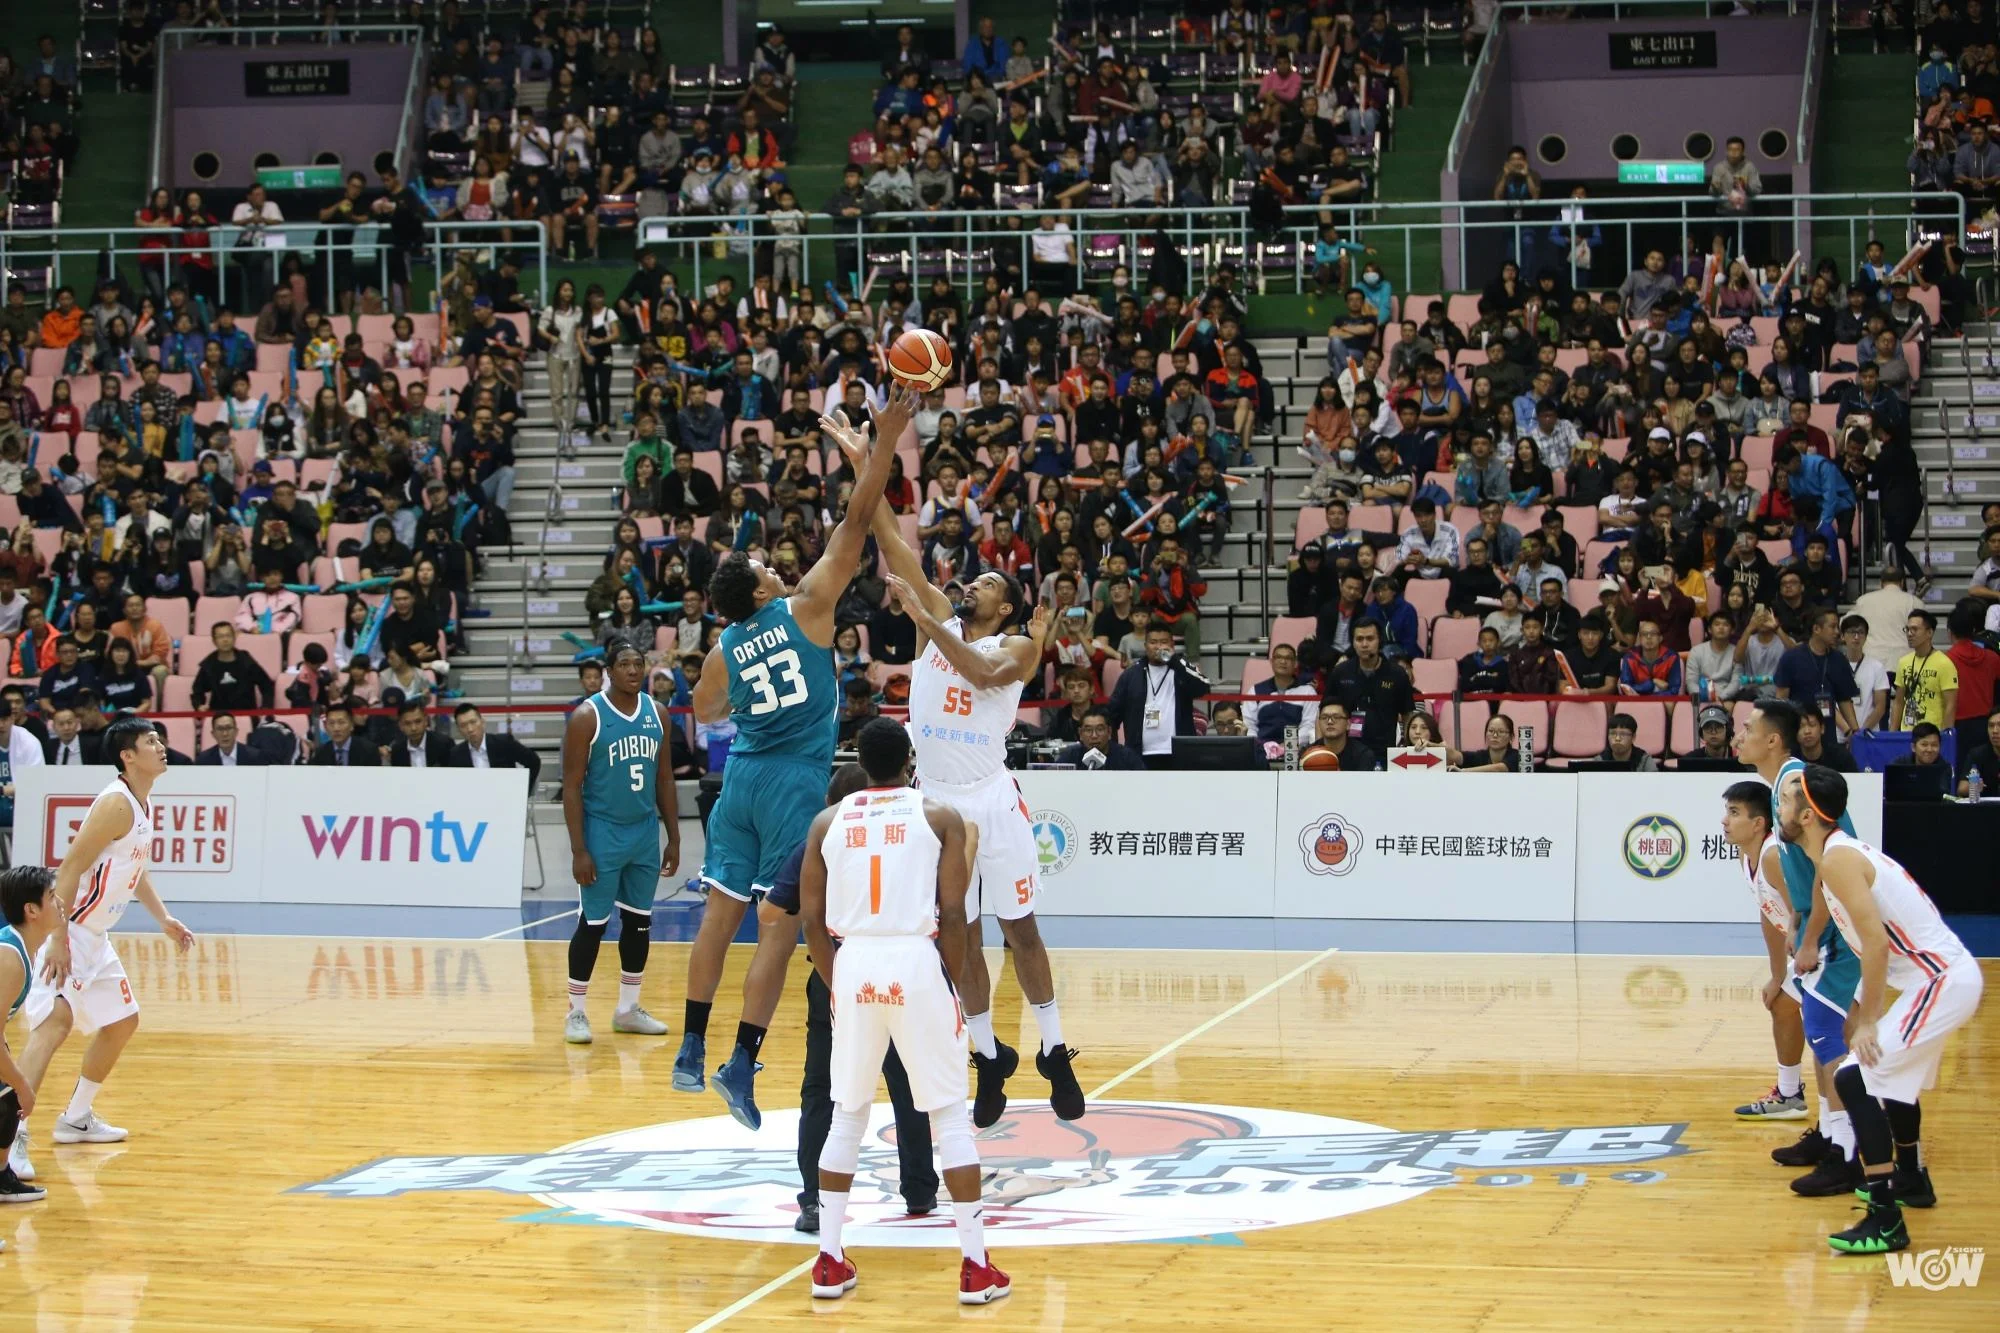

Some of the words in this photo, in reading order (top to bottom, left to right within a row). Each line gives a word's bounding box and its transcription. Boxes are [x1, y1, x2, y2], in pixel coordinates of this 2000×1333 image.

[1630, 36, 1694, 51] 東七出口
[733, 624, 789, 664] ORTON
[740, 648, 808, 715] 33
[943, 686, 972, 716] 55
[1525, 730, 1532, 738] 5
[608, 735, 658, 767] FUBON
[630, 764, 644, 792] 5
[153, 805, 227, 832] EVEN
[301, 810, 488, 862] wintv
[1089, 831, 1245, 856] 教育部體育署
[1375, 834, 1553, 858] 中華民國籃球協會
[1638, 838, 1672, 856] 桃園
[151, 838, 227, 864] ORTS
[869, 855, 881, 914] 1
[856, 993, 905, 1006] DEFENSE
[1132, 1120, 1709, 1180] 再起
[1121, 1169, 1668, 1198] 2018-2019
